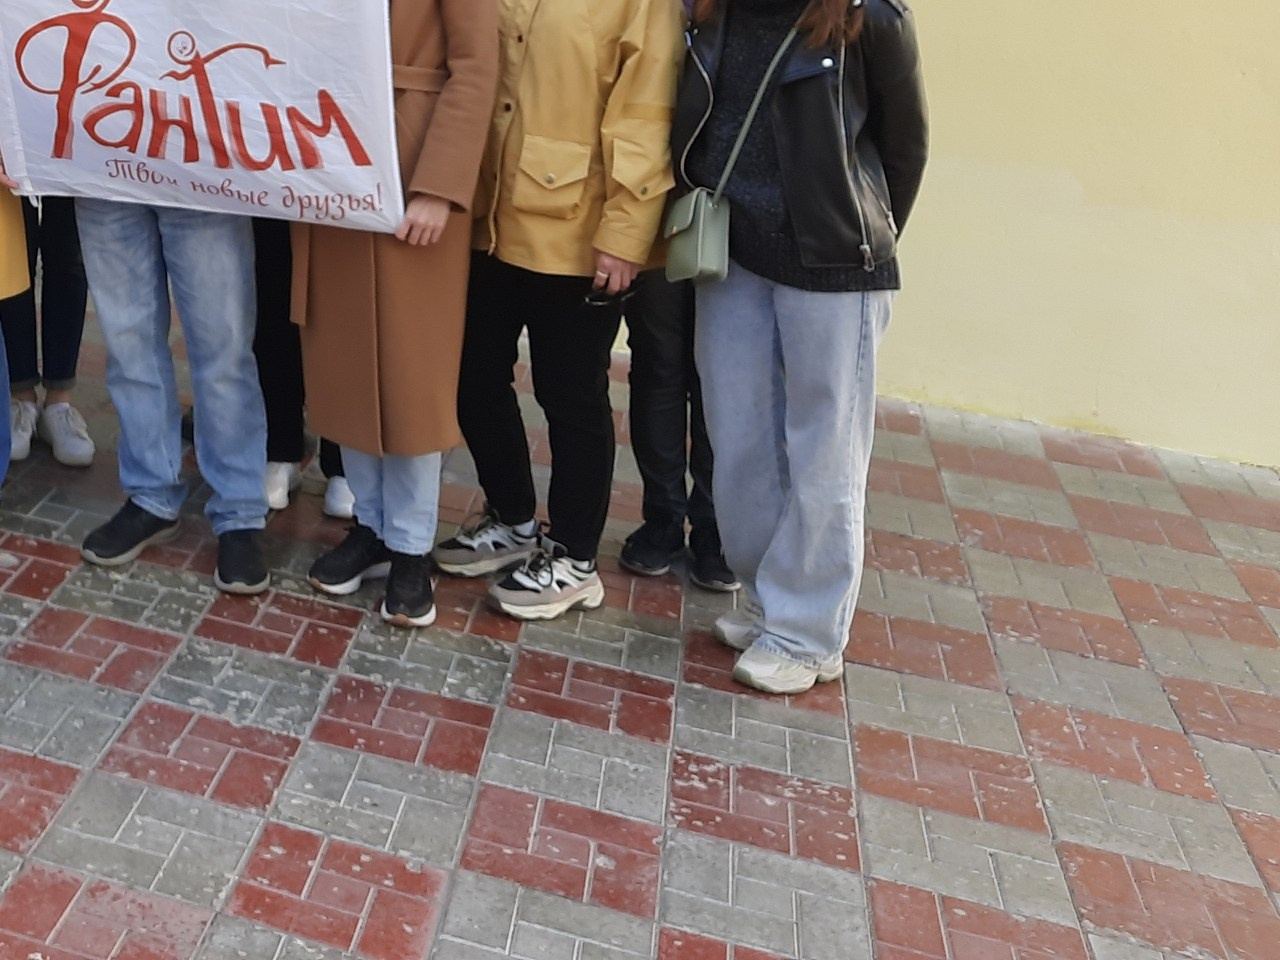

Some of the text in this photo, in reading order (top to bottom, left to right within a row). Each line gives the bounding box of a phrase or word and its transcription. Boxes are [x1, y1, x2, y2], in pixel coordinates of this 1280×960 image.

[105, 158, 383, 221] Твои новые друзья!
